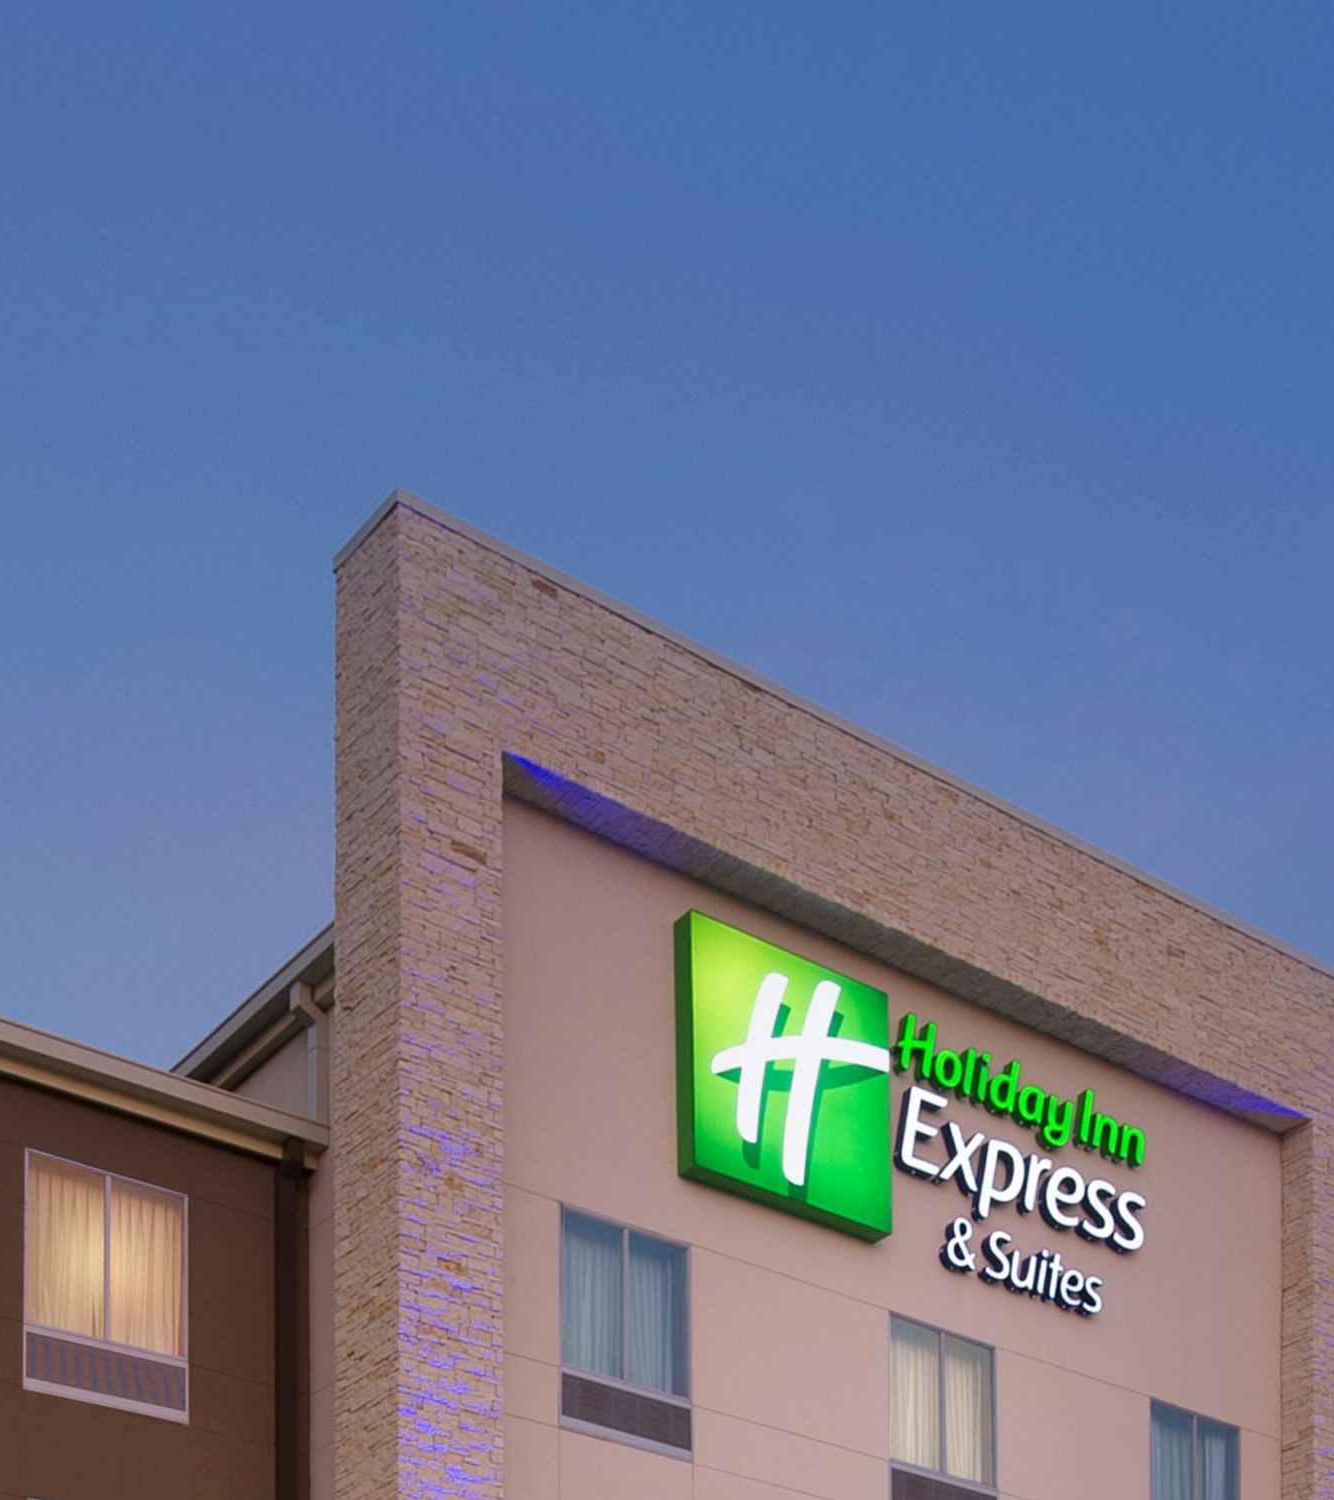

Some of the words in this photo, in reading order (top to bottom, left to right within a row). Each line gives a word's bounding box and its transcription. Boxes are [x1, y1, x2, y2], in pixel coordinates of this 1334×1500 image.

[897, 1013, 1072, 1147] Holiday
[1081, 1089, 1146, 1167] Inn
[897, 1086, 1147, 1252] Express
[943, 1217, 975, 1271] &
[981, 1231, 1104, 1314] Suites
